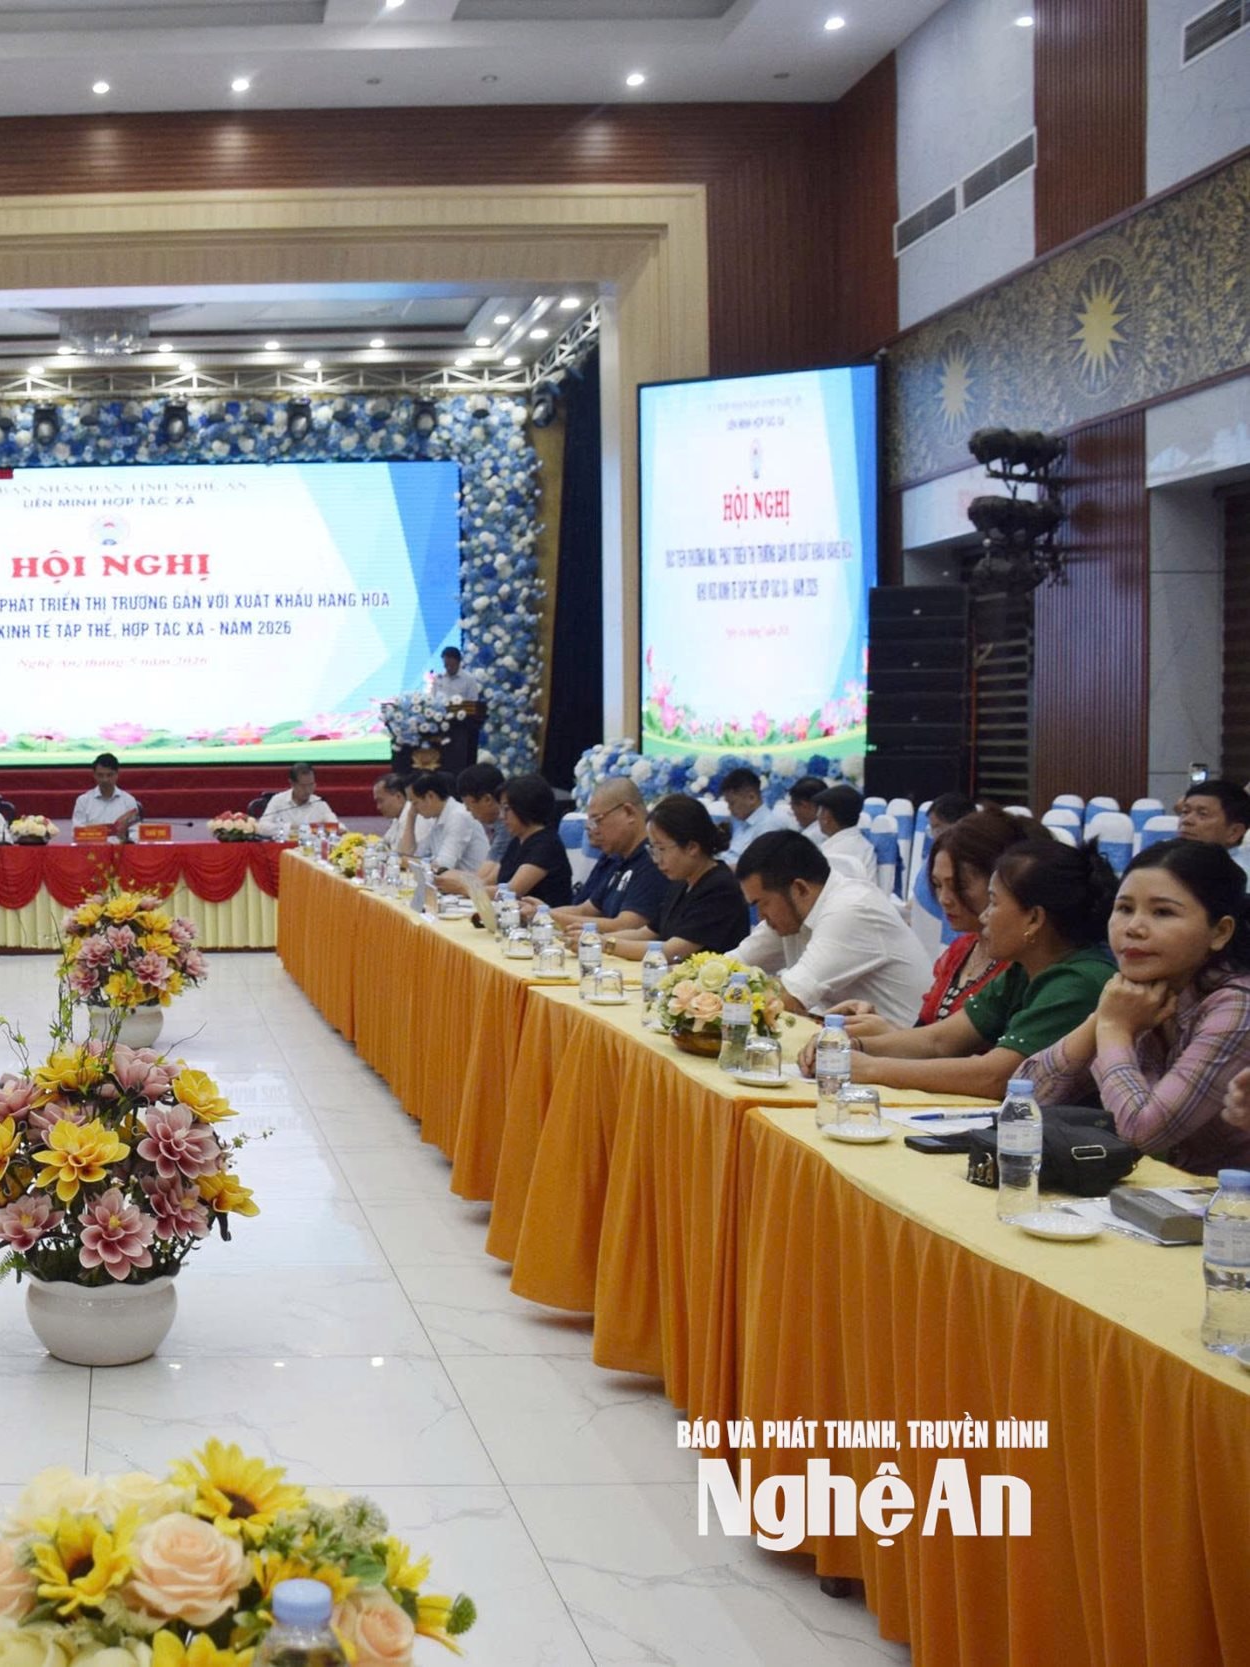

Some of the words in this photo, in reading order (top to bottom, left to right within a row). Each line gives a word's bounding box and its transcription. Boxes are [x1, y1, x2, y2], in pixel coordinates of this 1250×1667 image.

[57, 498, 97, 508] MINH
[722, 485, 749, 529] HỘI
[753, 489, 791, 526] NGHỊ
[11, 549, 87, 584] HỘI
[102, 553, 210, 582] NGHỊ
[257, 619, 292, 636] 2026
